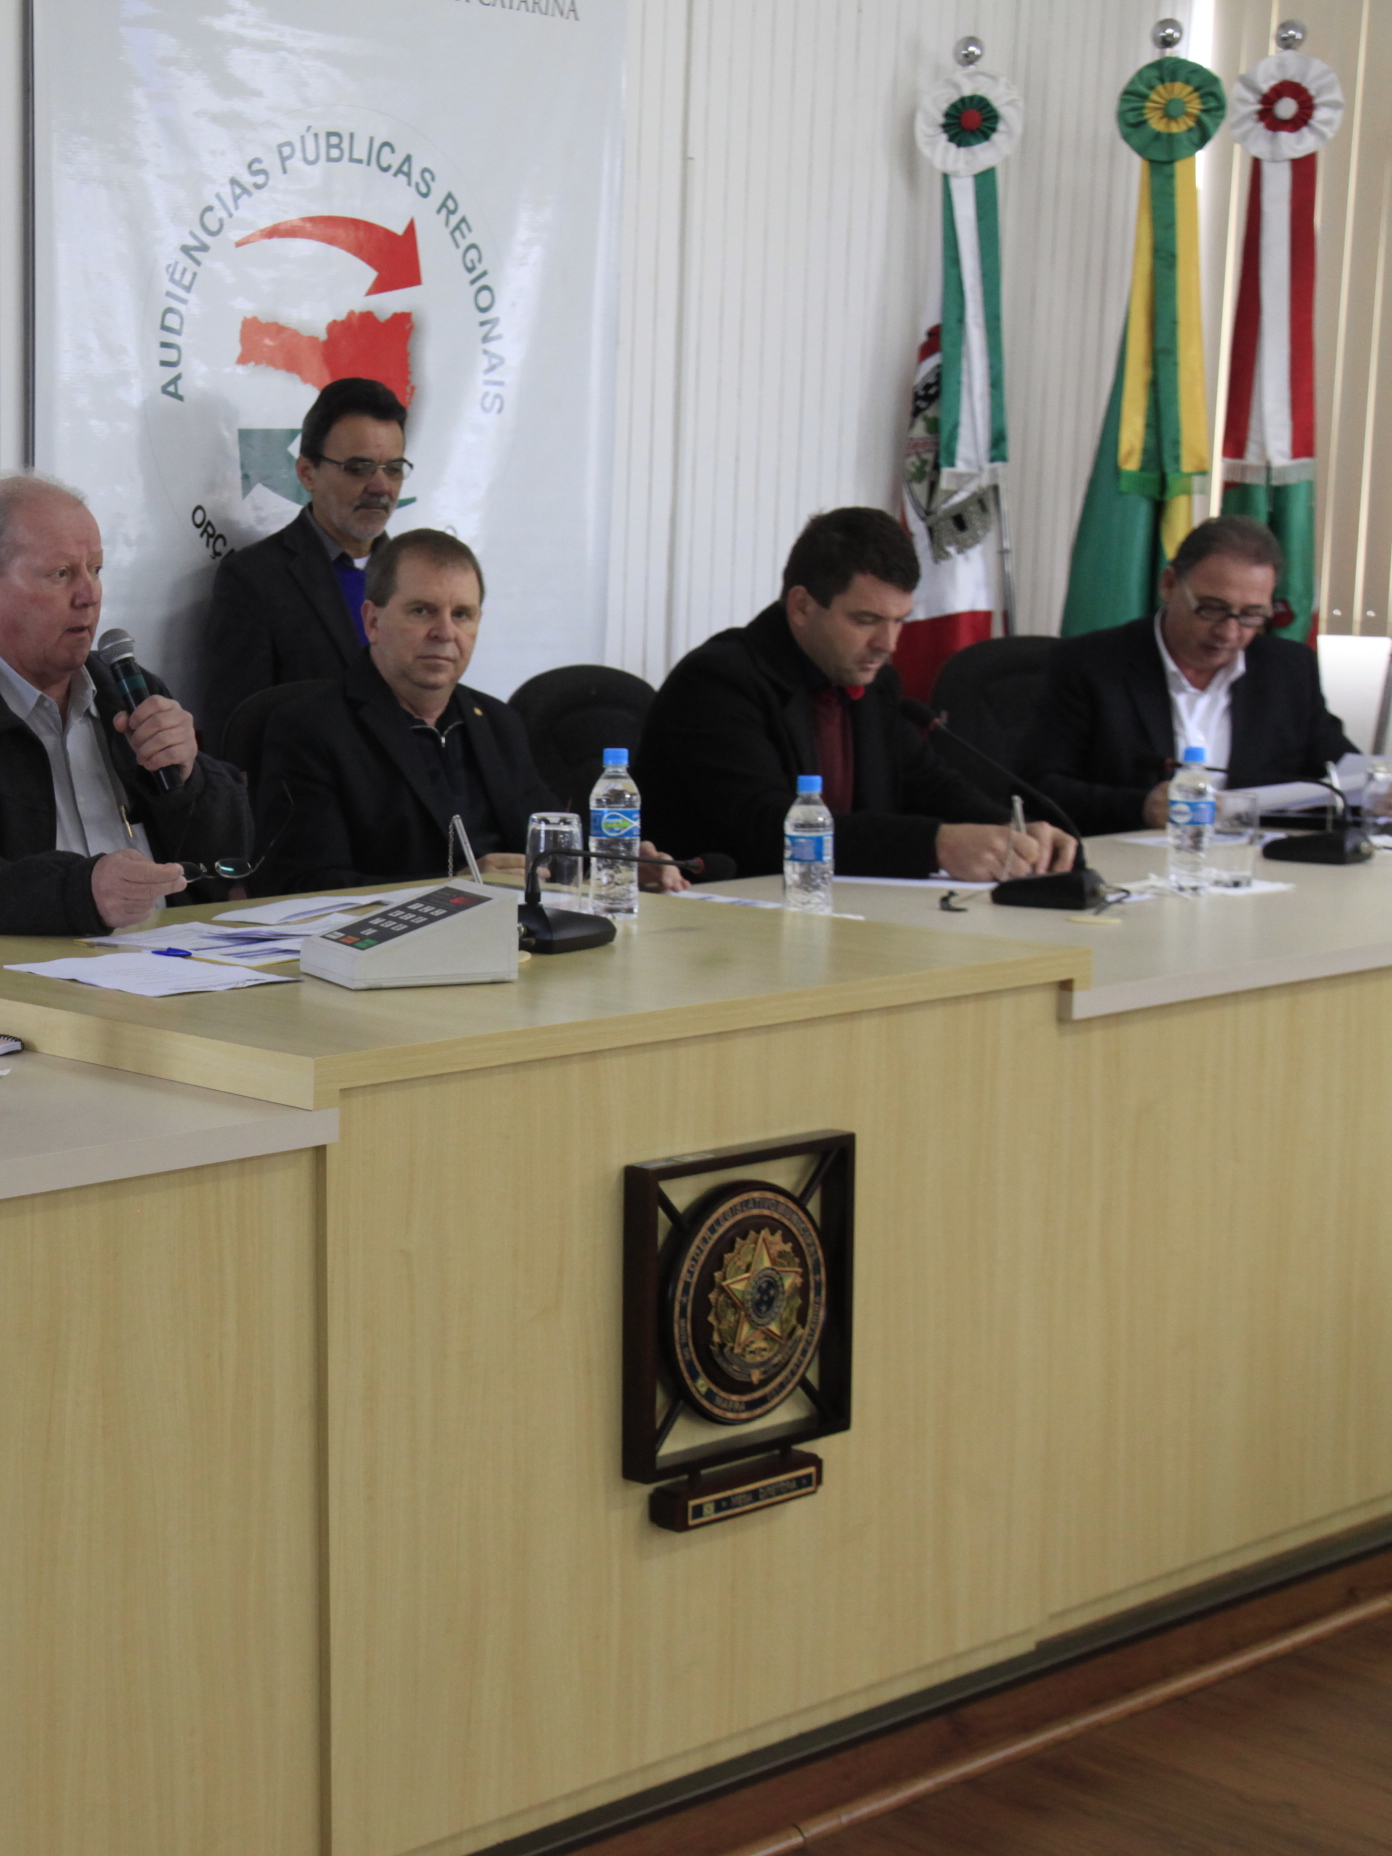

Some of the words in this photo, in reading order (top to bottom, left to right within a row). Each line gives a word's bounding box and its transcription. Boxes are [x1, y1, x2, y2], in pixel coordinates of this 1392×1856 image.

[478, 0, 580, 21] ARINA
[159, 156, 270, 403] AUDIÊNCIAS
[276, 125, 436, 199] PÚBLICAS
[436, 191, 505, 415] REGIONAIS
[191, 504, 235, 560] ORÇ
